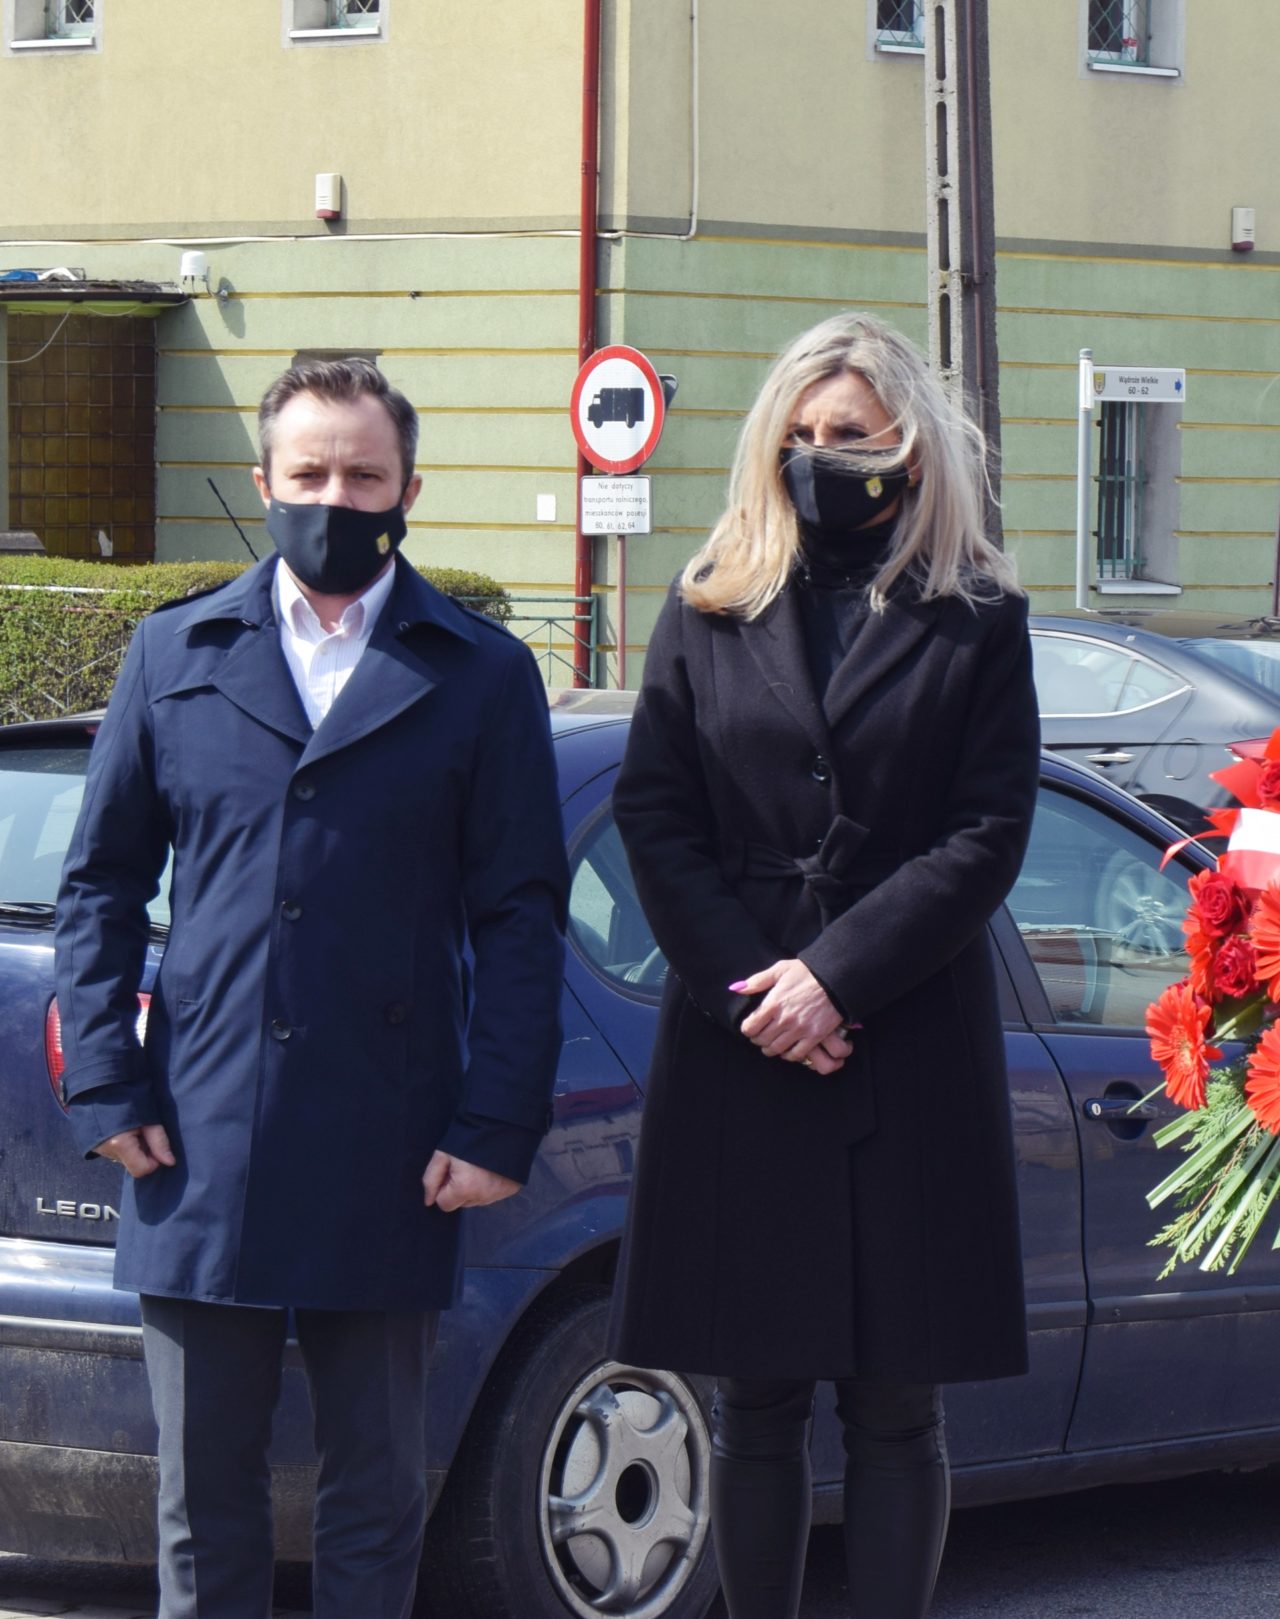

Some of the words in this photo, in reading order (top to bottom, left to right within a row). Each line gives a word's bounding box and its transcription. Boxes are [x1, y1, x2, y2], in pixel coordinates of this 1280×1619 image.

[1141, 376, 1158, 384] Wielkie
[1128, 386, 1136, 394] 60
[1141, 386, 1149, 394] 62
[611, 482, 633, 491] dotyczy
[37, 1197, 120, 1221] LEON
